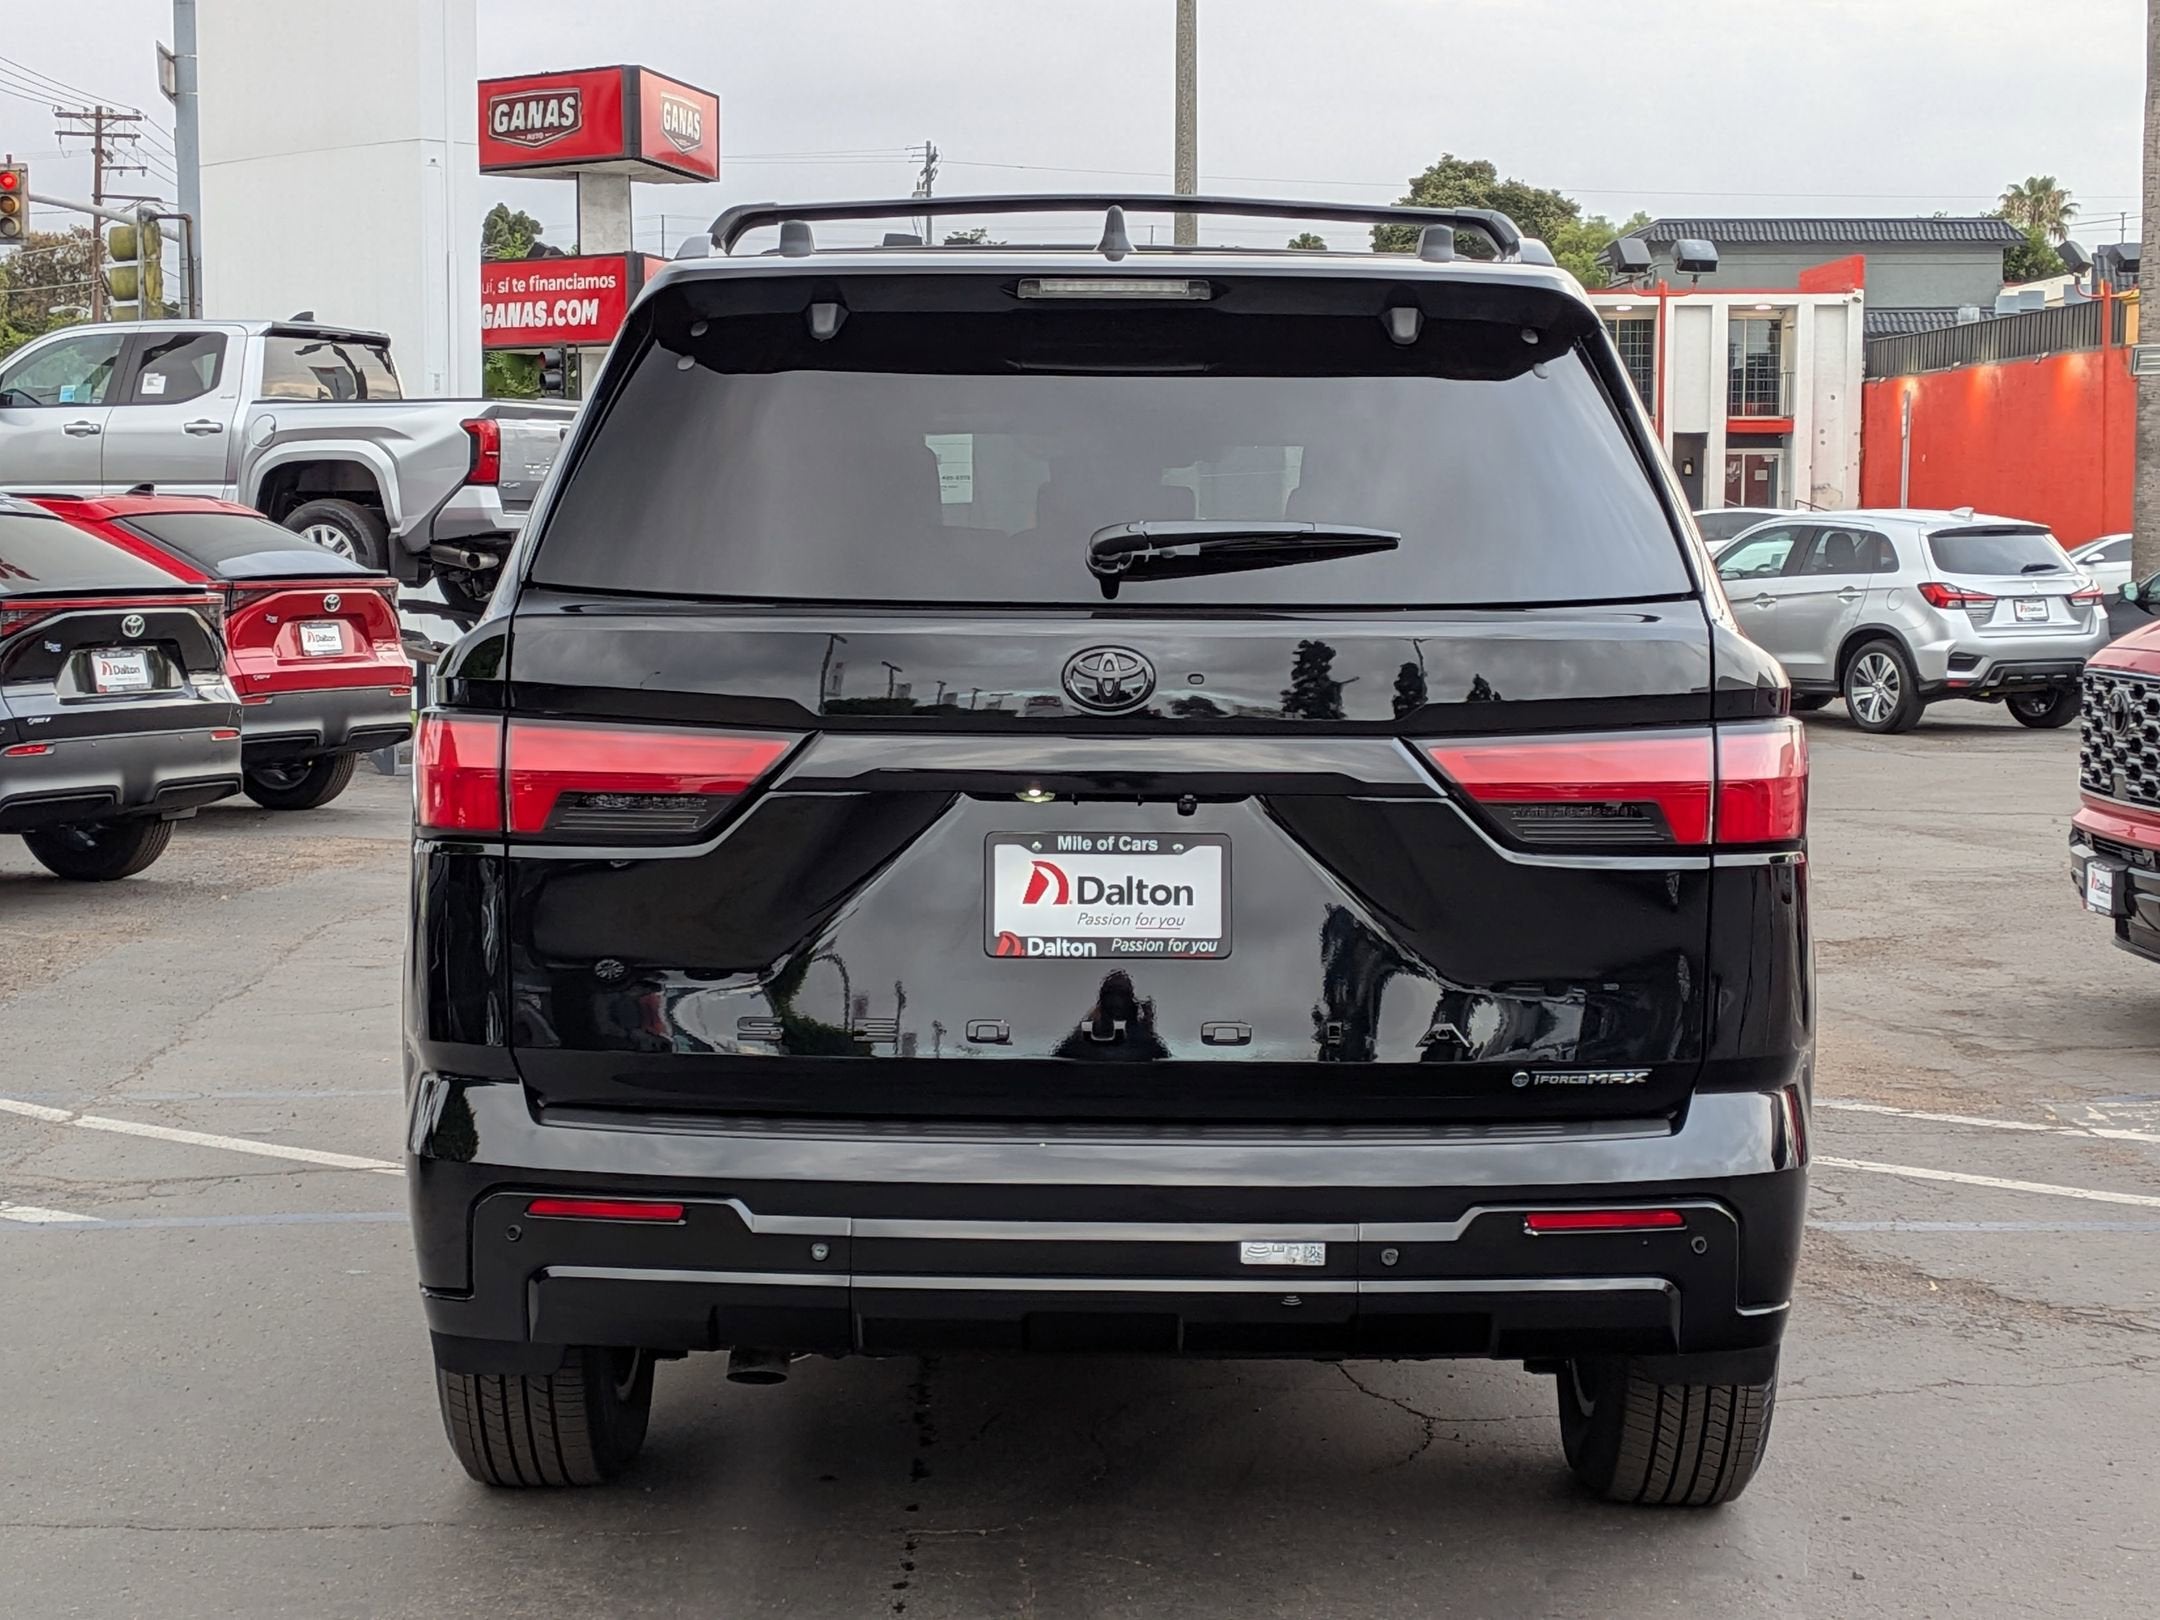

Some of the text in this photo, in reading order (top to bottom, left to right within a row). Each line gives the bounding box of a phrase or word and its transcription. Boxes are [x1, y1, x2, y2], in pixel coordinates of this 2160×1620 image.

[494, 96, 576, 133] GANAS
[663, 102, 700, 140] GANAS
[497, 276, 510, 294] sí
[512, 278, 526, 293] te
[529, 272, 617, 292] financiamos
[480, 298, 599, 330] GANAS.COM
[113, 664, 141, 675] Dalton
[1057, 835, 1158, 852] Mile of Cars
[1077, 875, 1194, 906] Dalton
[1077, 912, 1186, 929] Passion for you
[1027, 938, 1218, 957] Dalton Passion for you
